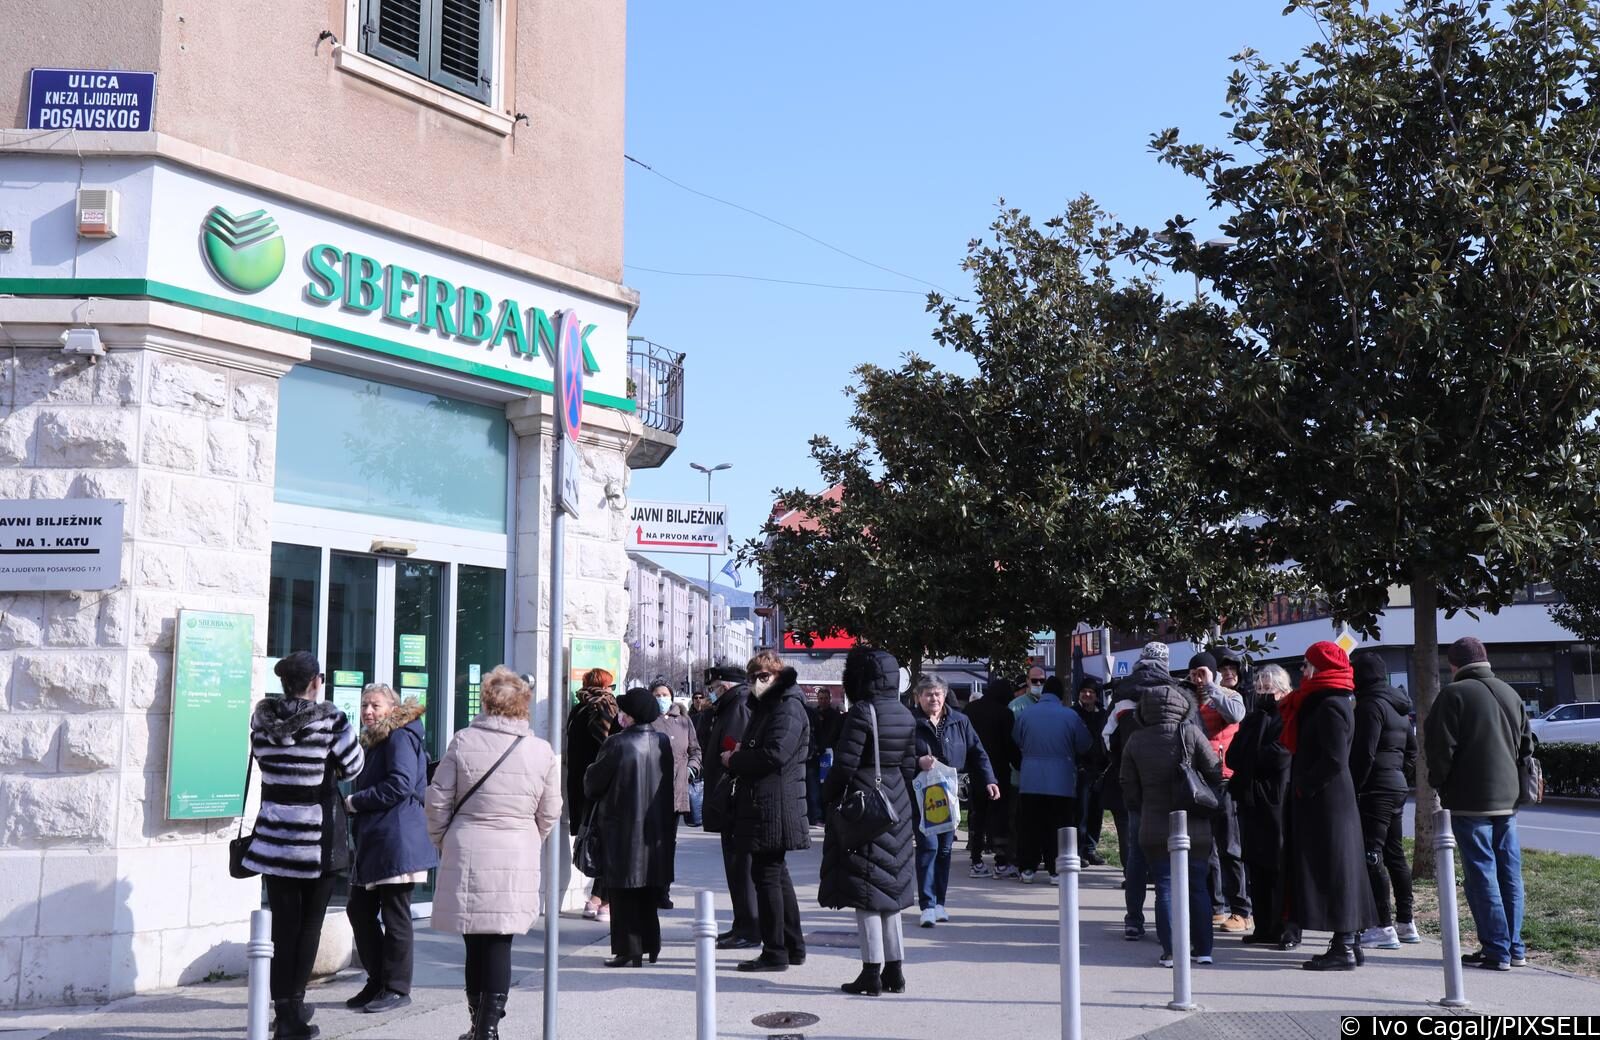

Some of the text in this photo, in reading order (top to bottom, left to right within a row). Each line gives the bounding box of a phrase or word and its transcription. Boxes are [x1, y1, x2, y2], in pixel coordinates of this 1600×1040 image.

[68, 74, 120, 89] ULICA
[45, 91, 139, 106] KNEZA LJUDEVITA
[39, 108, 140, 129] POSAVSKOG
[0, 514, 103, 527] AVNI BILJEŽNIK
[630, 506, 724, 526] JAVNI BILJEŽNIK
[16, 537, 90, 547] NA 1. KATU
[645, 532, 714, 542] NA PRVOM KATU
